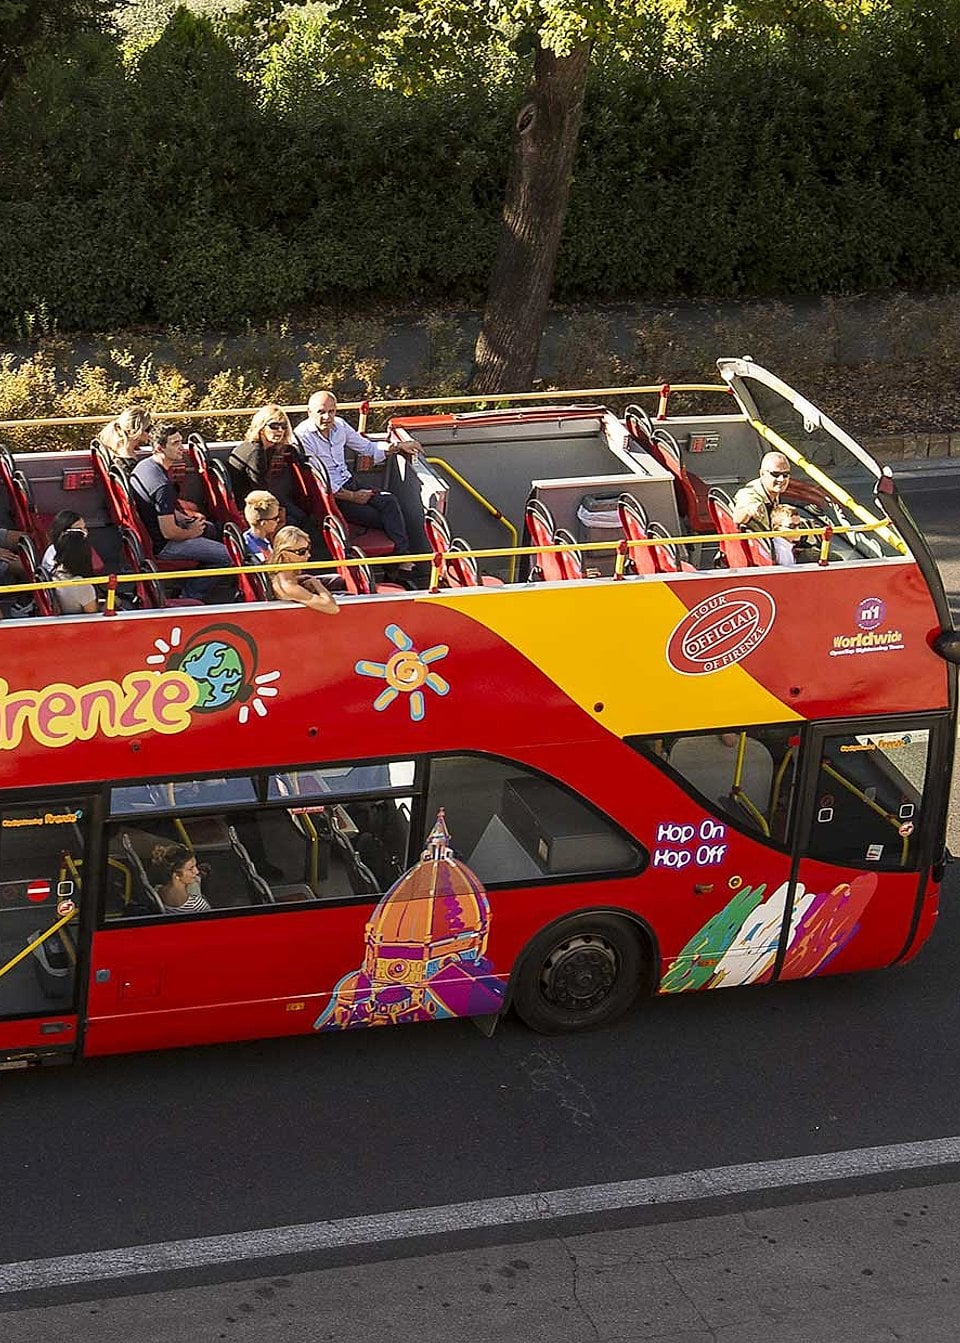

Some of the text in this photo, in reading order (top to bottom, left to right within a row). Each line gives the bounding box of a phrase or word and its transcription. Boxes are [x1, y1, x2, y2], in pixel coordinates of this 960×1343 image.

[691, 596, 728, 620] TOUR
[685, 607, 758, 655] OFFICIAL
[703, 626, 765, 672] OF FIRENZE
[657, 820, 725, 843] Hop On
[653, 845, 727, 868] Hop Off
